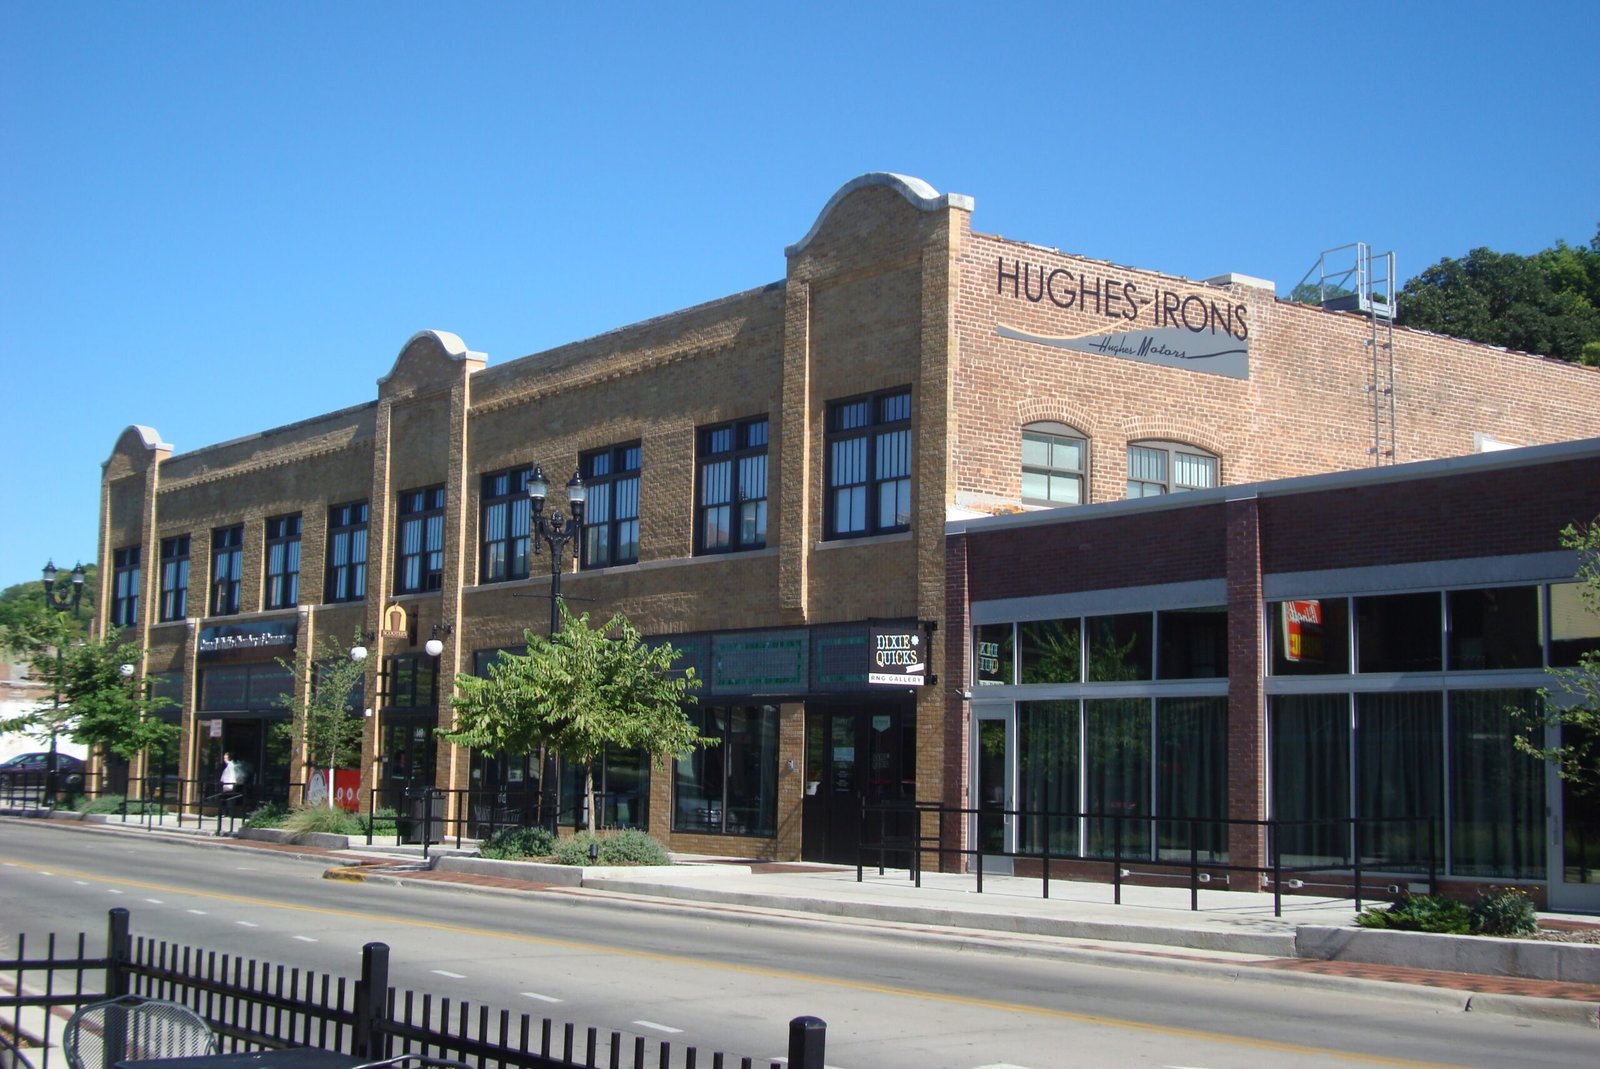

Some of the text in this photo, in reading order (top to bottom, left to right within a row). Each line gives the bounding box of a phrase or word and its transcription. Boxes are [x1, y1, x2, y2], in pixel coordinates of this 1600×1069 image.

[997, 256, 1249, 342] HUGHES-IRONS
[1094, 335, 1187, 359] Hughes Motors
[876, 634, 911, 649] DIXIE
[876, 650, 918, 667] QUICKS
